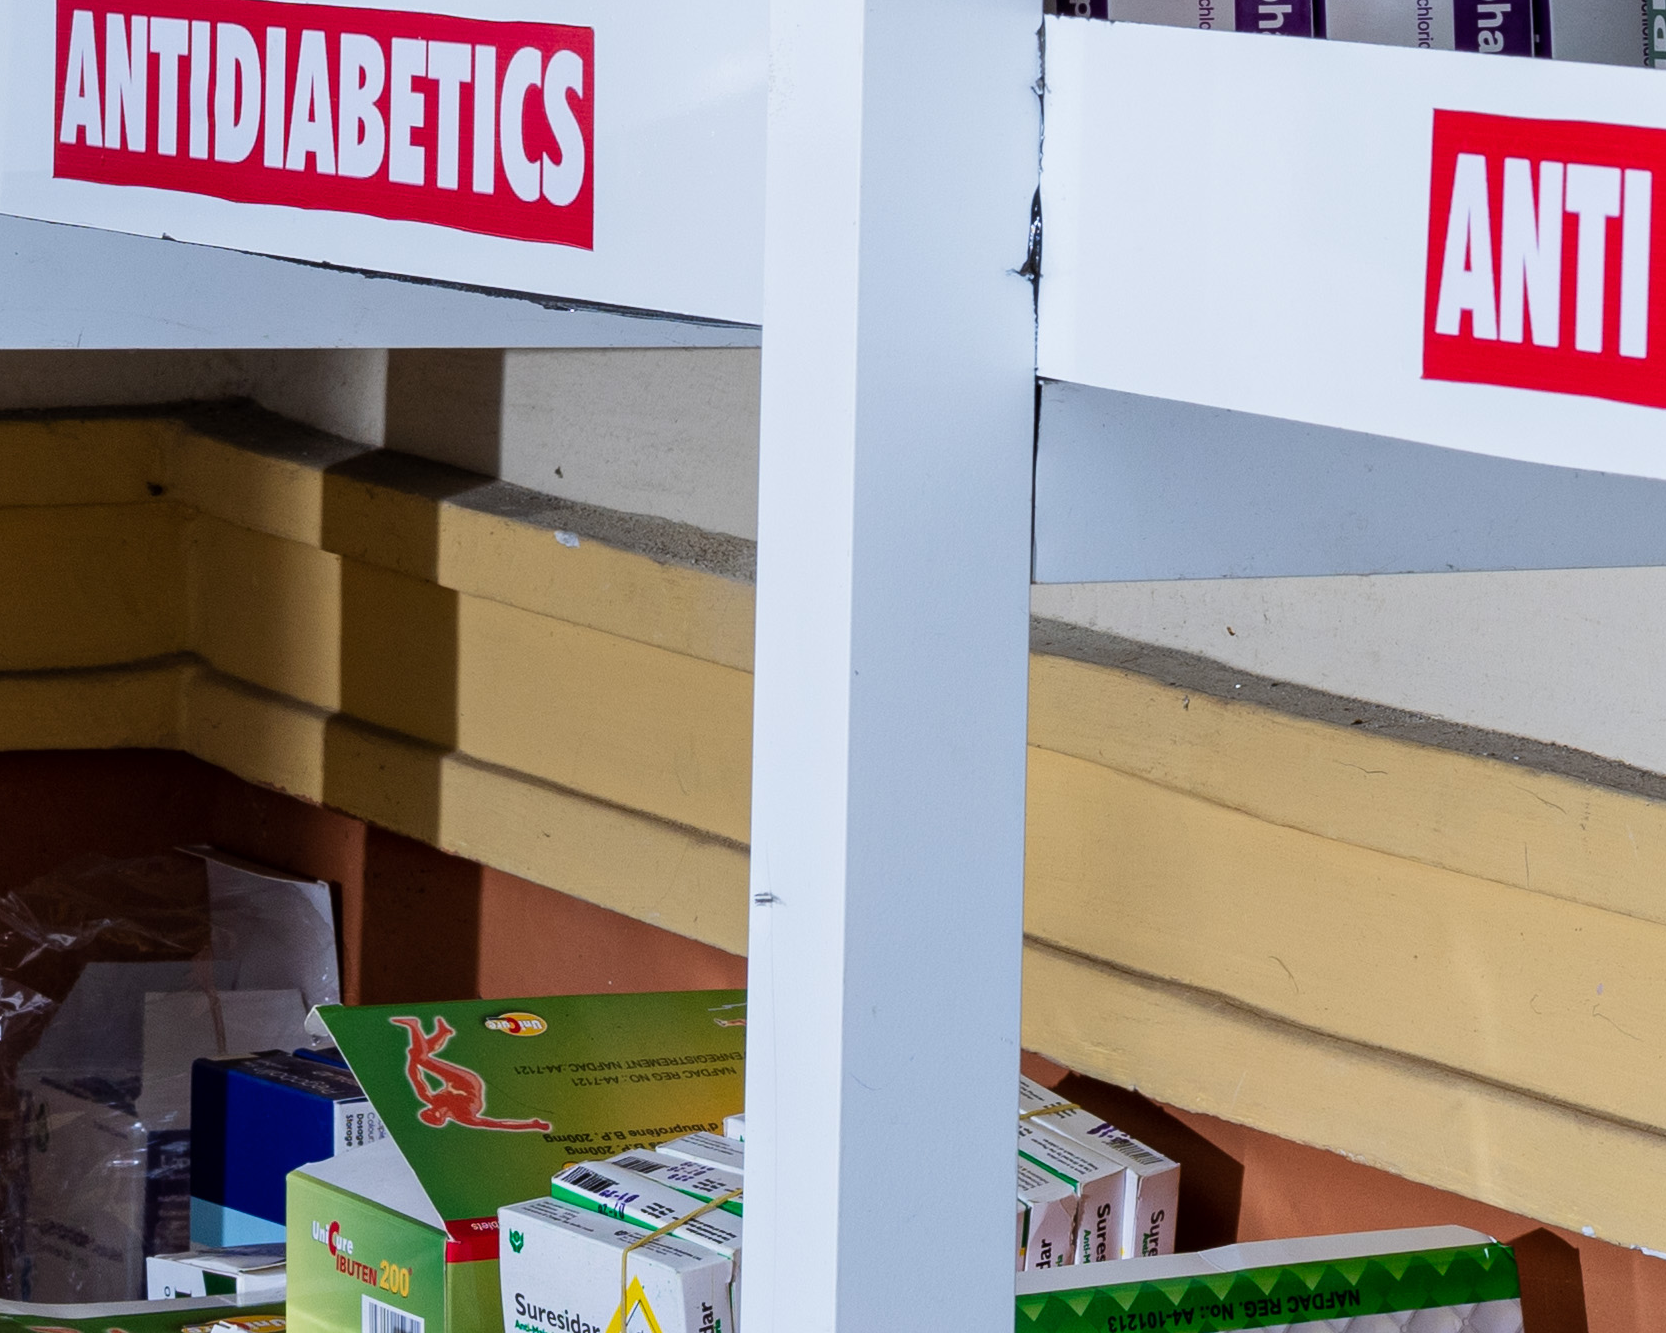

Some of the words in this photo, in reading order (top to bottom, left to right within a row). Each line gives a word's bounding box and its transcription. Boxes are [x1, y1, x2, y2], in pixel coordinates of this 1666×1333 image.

[58, 8, 586, 207] ANTIDIABETICS
[1434, 151, 1653, 360] ANTI
[335, 1254, 378, 1288] IBUTEN
[379, 1260, 410, 1299] 200
[515, 1293, 600, 1332] Suresidar
[1108, 1306, 1194, 1332] A4-101213
[1239, 1297, 1283, 1319] REG.
[1287, 1289, 1361, 1313] NAFDAC
